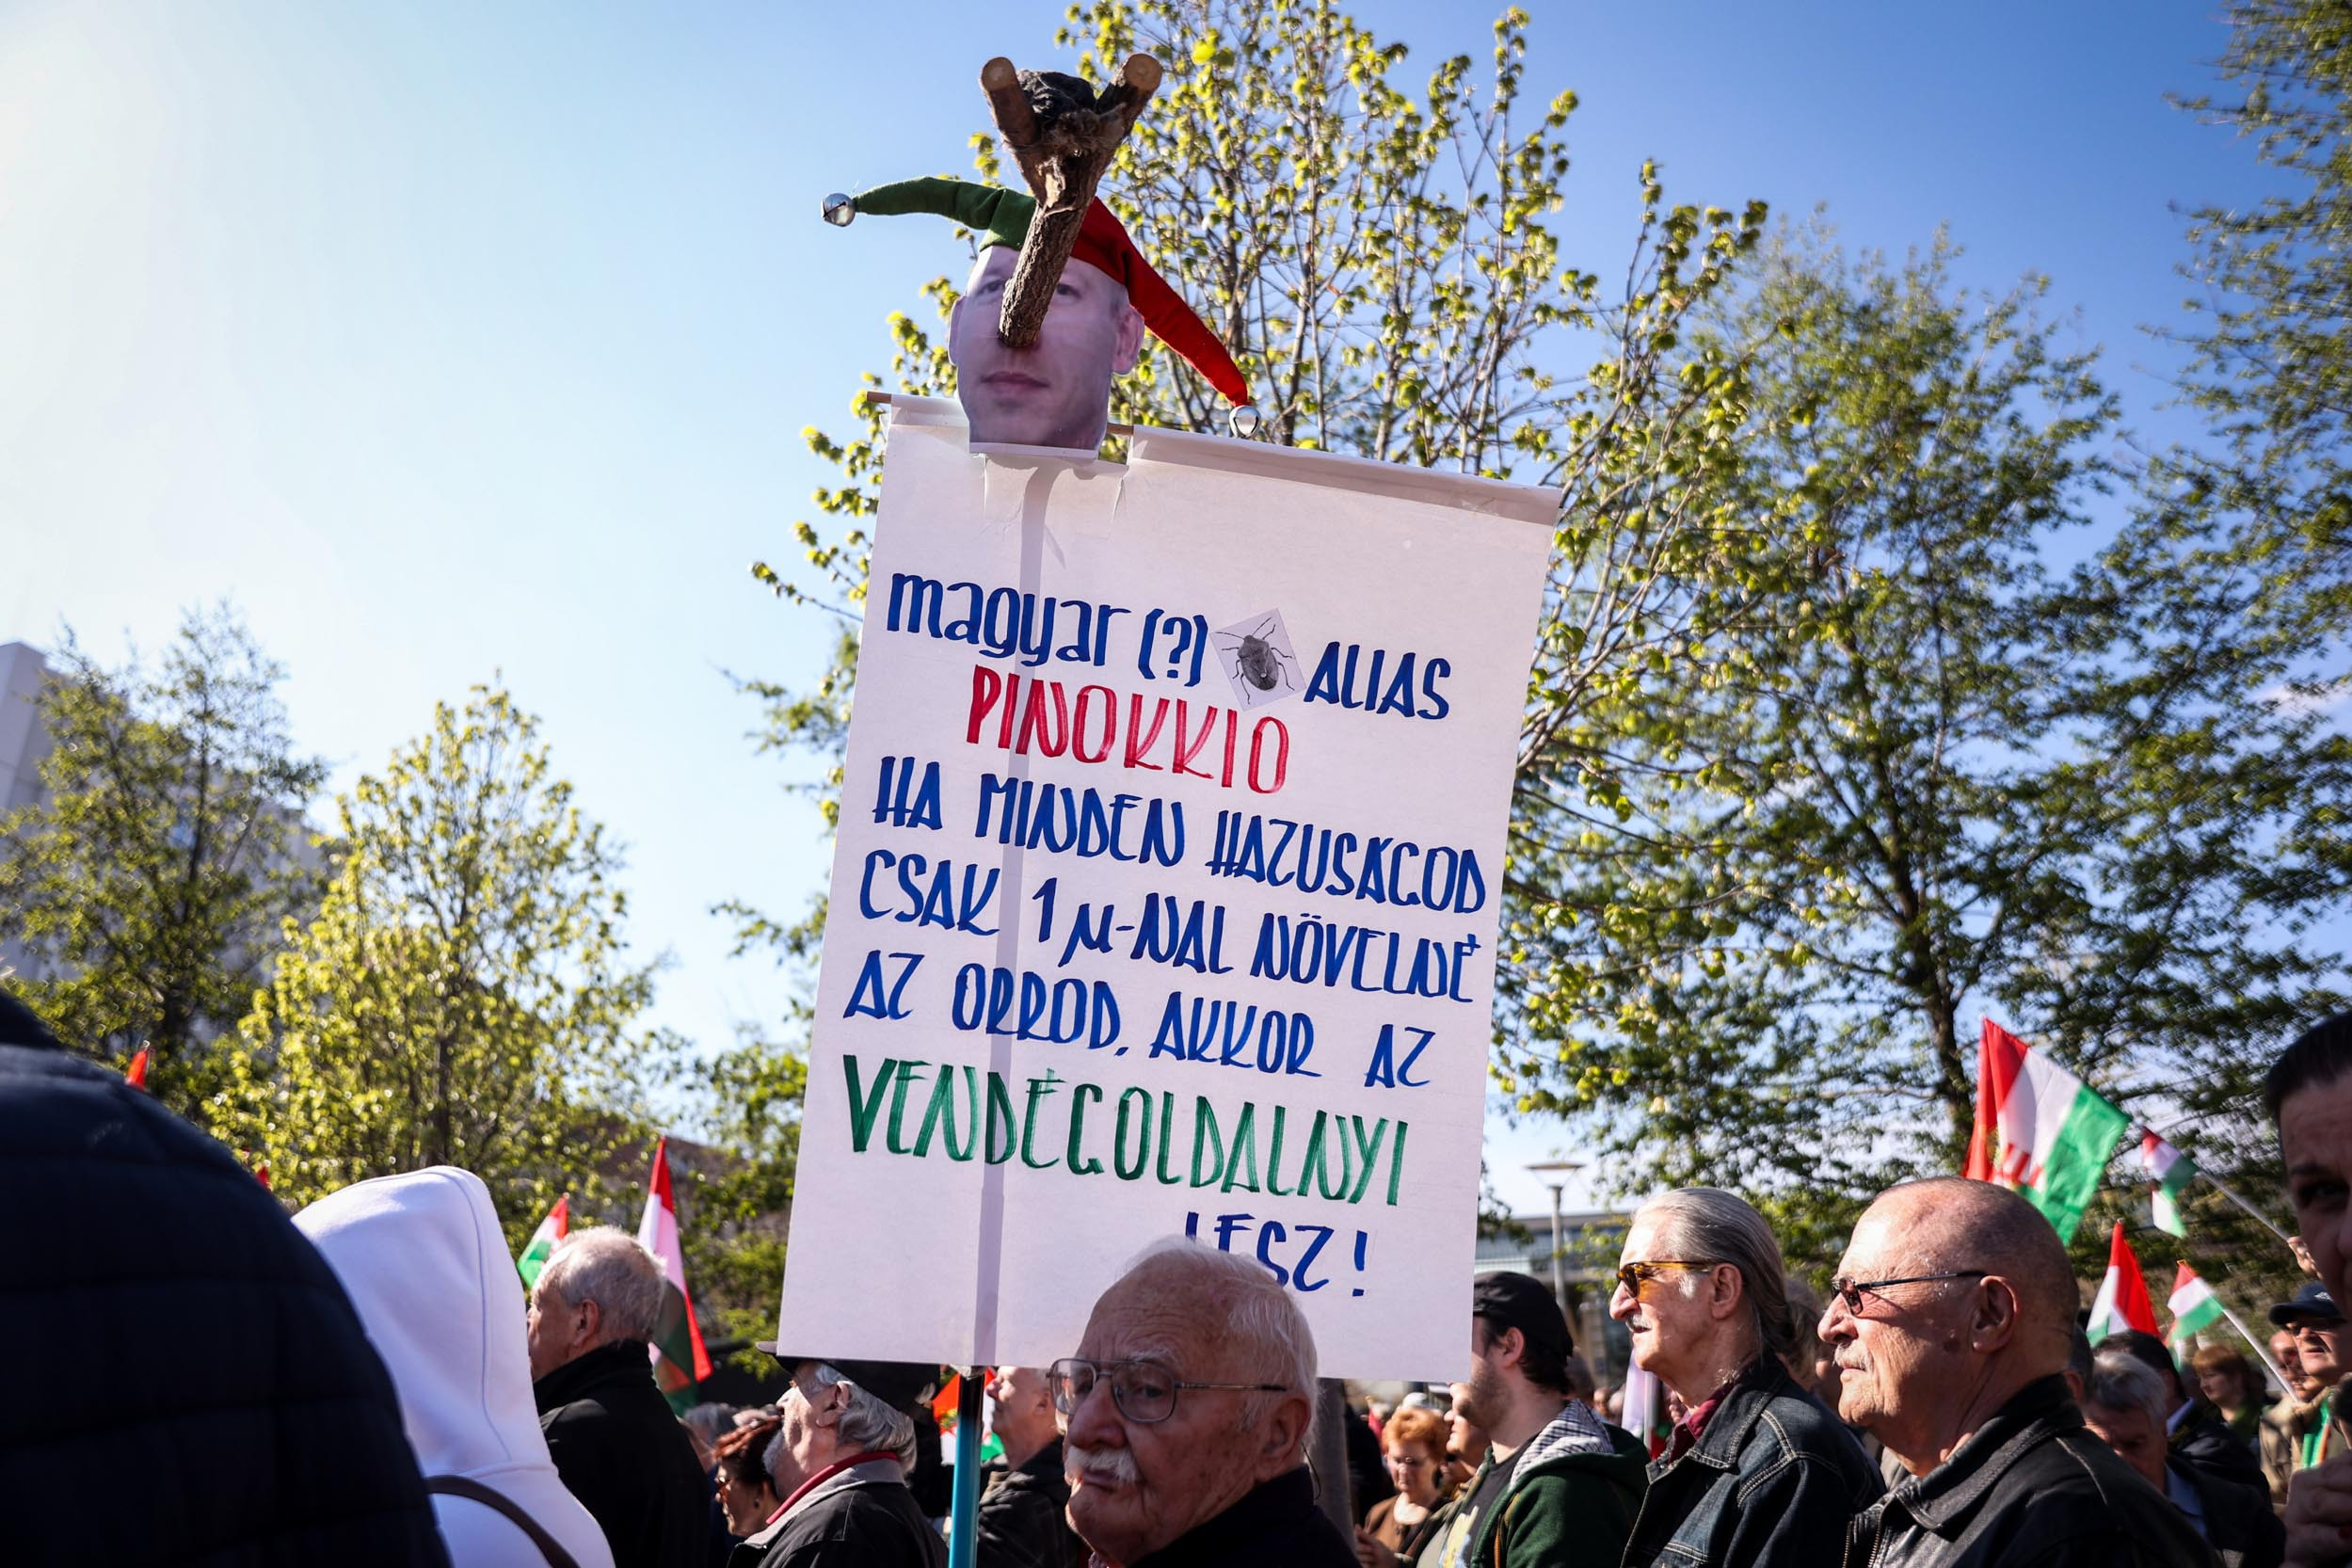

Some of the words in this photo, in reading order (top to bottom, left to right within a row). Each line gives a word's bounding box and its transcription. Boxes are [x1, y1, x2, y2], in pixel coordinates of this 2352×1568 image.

[888, 572, 1130, 666] magyar
[1138, 608, 1208, 687] (?)
[1304, 641, 1451, 720] ALIAS
[966, 664, 1289, 794] PINOKKIO
[872, 756, 943, 831] HA
[974, 773, 1185, 868] MINDEN
[859, 849, 1000, 936] CSAK
[1032, 877, 1057, 943] 1
[842, 950, 925, 1020] AZ
[1148, 991, 1321, 1078] AKKOR
[1364, 1023, 1436, 1088] AZ
[843, 1055, 1408, 1206] VENDÉGOLDALNYI
